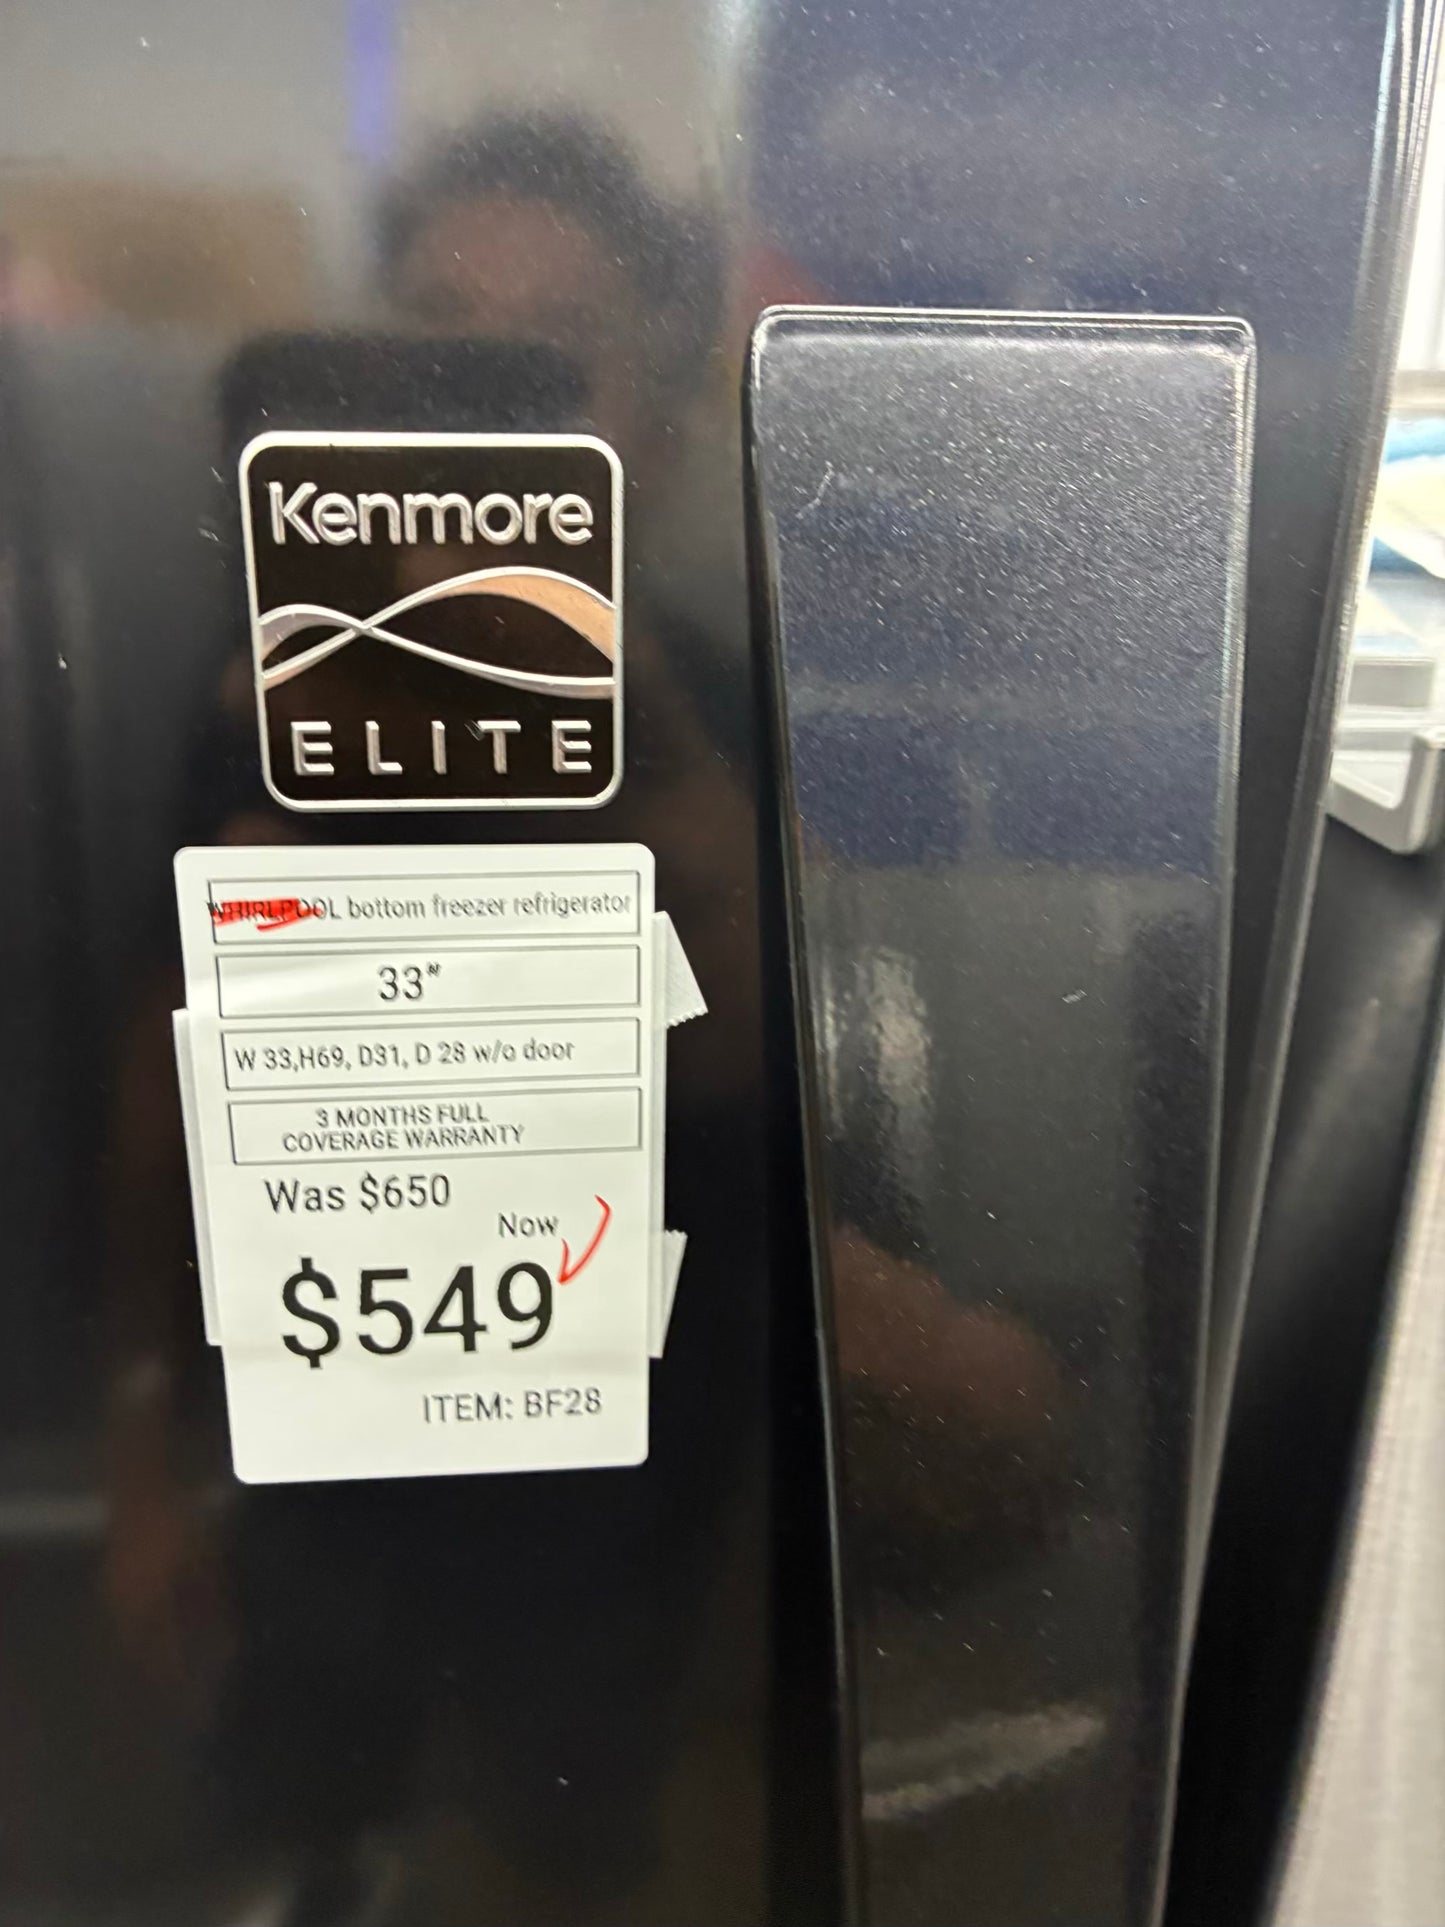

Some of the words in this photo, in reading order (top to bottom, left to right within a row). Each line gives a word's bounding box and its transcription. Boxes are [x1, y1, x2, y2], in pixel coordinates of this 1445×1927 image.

[268, 481, 594, 545] Kenmore
[290, 720, 593, 776] ELITE
[348, 895, 426, 919] bottom
[432, 892, 507, 917] freezer
[513, 891, 631, 918] refrigerator
[234, 1046, 256, 1072] W
[358, 1043, 410, 1070] D31,
[415, 1042, 431, 1066] D
[438, 1041, 466, 1065] 28
[473, 1039, 517, 1064] w/o
[522, 1037, 575, 1062] door
[315, 1108, 329, 1129] 3
[336, 1105, 432, 1128] MONTHS
[438, 1102, 490, 1125] FULL
[282, 1127, 399, 1153] COVERAGE
[405, 1124, 525, 1148] WARRANTY
[264, 1178, 346, 1214] Was
[359, 1171, 450, 1214] $650
[498, 1212, 560, 1238] Now
[281, 1254, 554, 1370] $549
[423, 1393, 514, 1424] ITEM:
[523, 1387, 602, 1419] BF28
